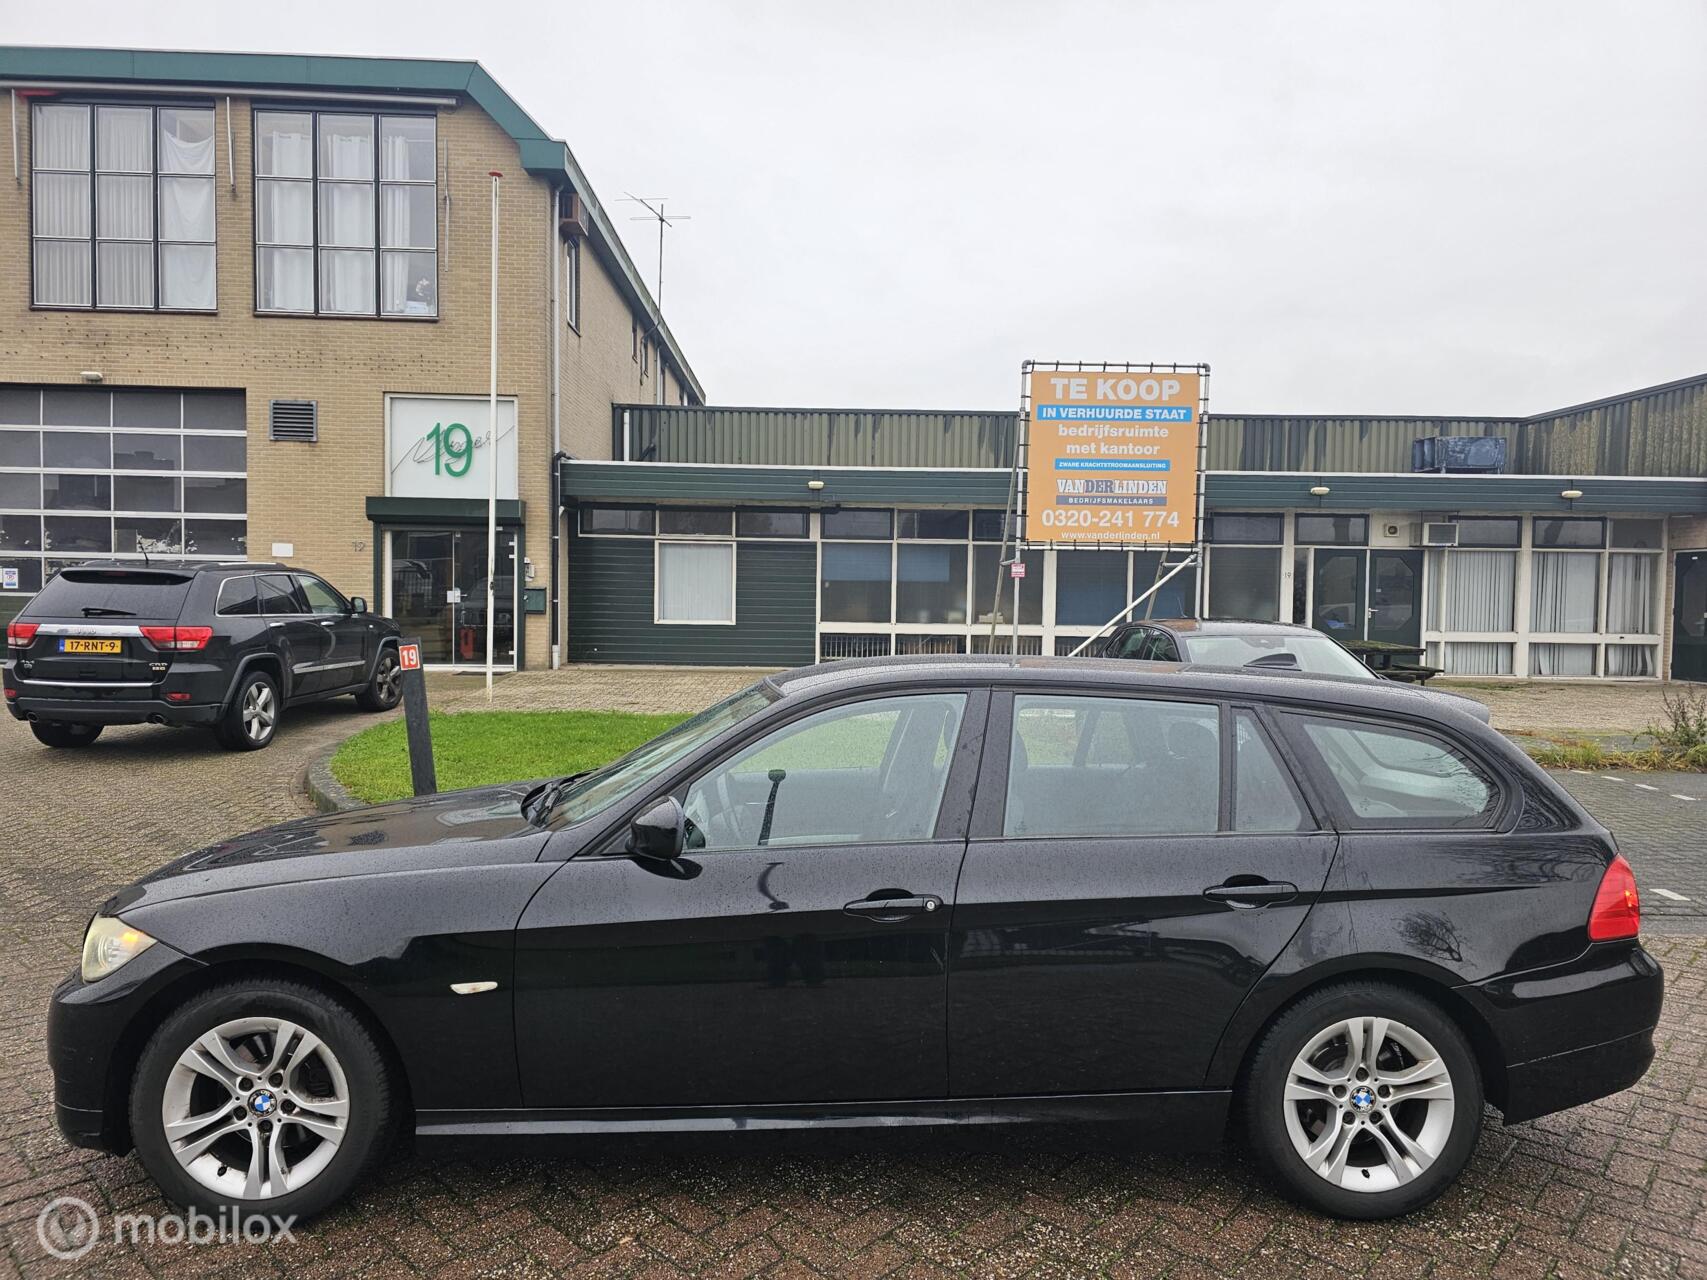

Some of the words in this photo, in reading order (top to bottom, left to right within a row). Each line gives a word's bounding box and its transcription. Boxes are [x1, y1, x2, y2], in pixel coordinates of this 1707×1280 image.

[1050, 377, 1088, 400] TE
[1096, 378, 1180, 401] KOOP
[1042, 407, 1057, 418] IN
[1059, 408, 1142, 419] VERHUURDE
[1145, 408, 1187, 420] STAAT
[1058, 424, 1169, 438] bedrijfsruimte
[426, 422, 473, 477] 19
[1066, 443, 1096, 454] met
[1100, 442, 1160, 455] kantoor
[1068, 497, 1154, 505] BEDRIJFSMAKELAARS
[1041, 509, 1134, 528] 0320-241
[1142, 511, 1180, 528] 774
[1061, 531, 1160, 540] www.vanderlinden.nl
[70, 639, 116, 651] 17-RNT-9
[402, 649, 417, 666] 19
